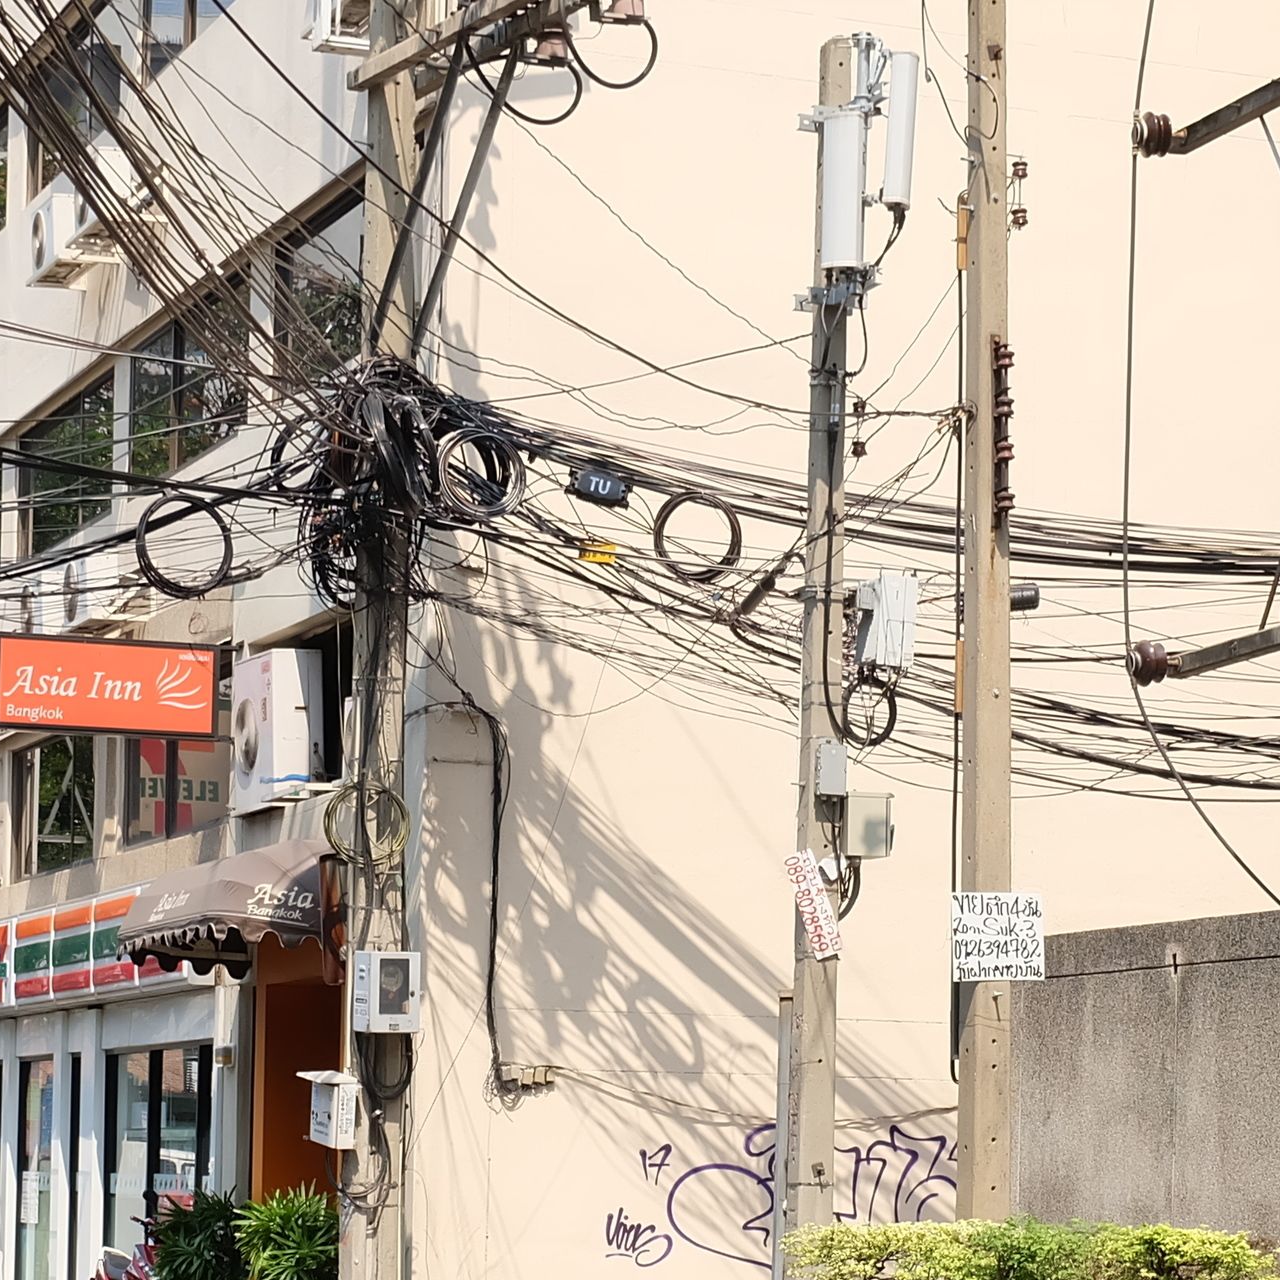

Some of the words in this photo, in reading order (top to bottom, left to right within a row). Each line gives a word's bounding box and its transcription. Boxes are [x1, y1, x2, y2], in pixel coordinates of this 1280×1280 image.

[2, 665, 77, 698] Asia
[87, 671, 142, 702] Inn
[6, 704, 64, 722] Bangkok
[247, 882, 315, 909] Asia
[246, 904, 303, 921] Bangkok
[639, 1143, 672, 1186] 17
